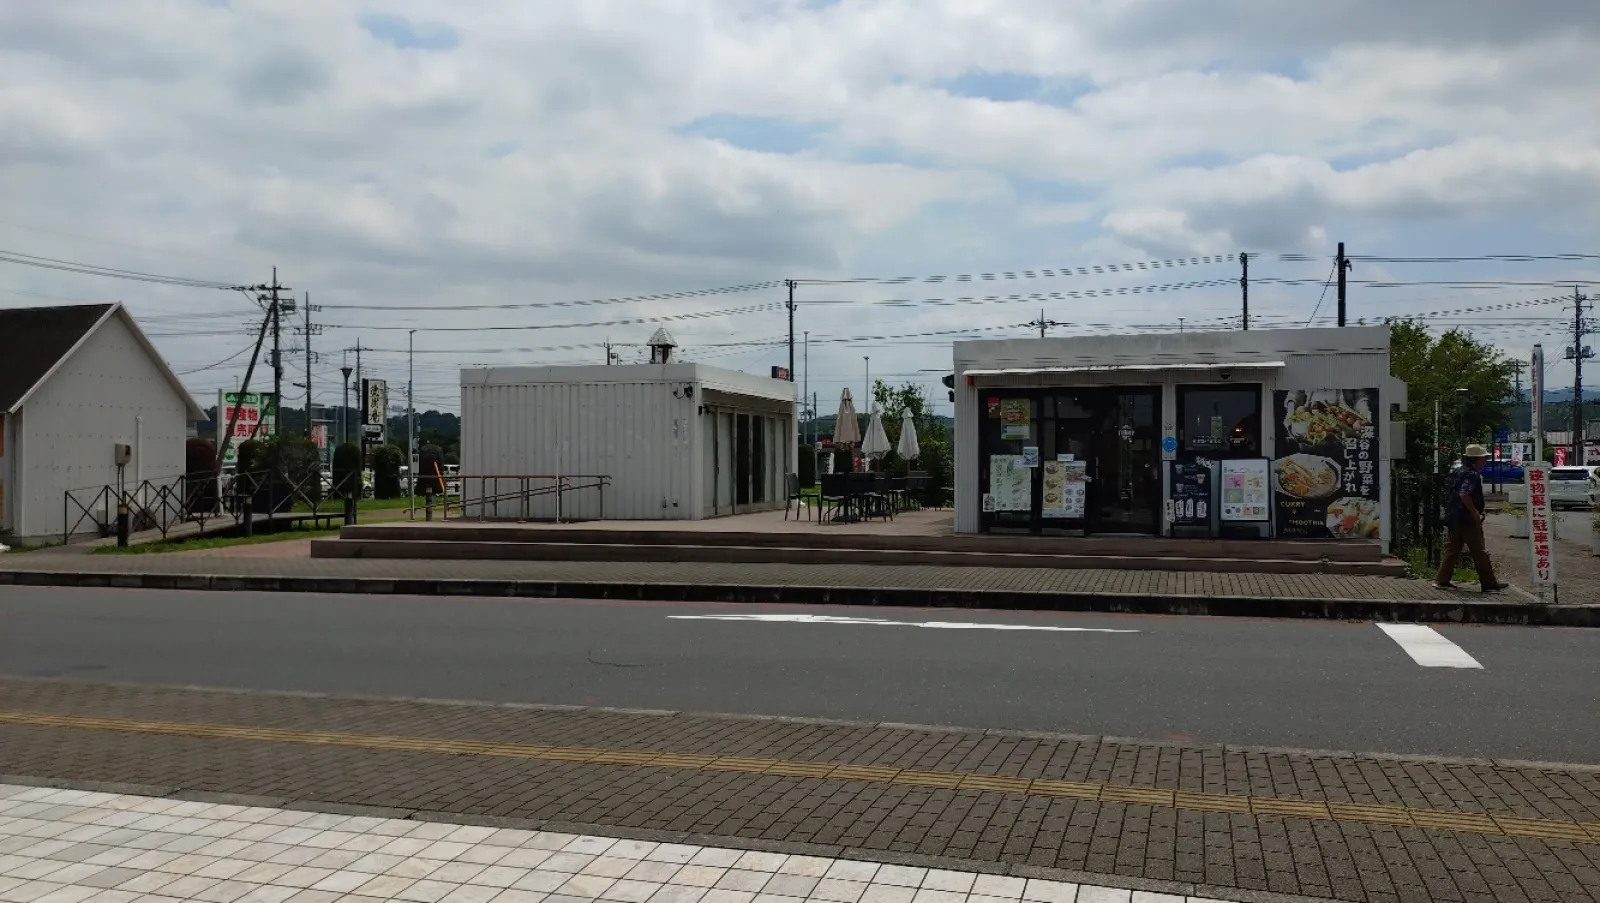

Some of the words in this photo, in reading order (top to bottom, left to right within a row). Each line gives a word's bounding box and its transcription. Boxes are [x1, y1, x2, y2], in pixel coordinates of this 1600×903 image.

[225, 423, 257, 437] 売所
[1358, 425, 1375, 496] 深谷の野菜を
[1342, 437, 1357, 493] 召し上がれ
[1528, 469, 1551, 581] 建物裏に駐車場あり
